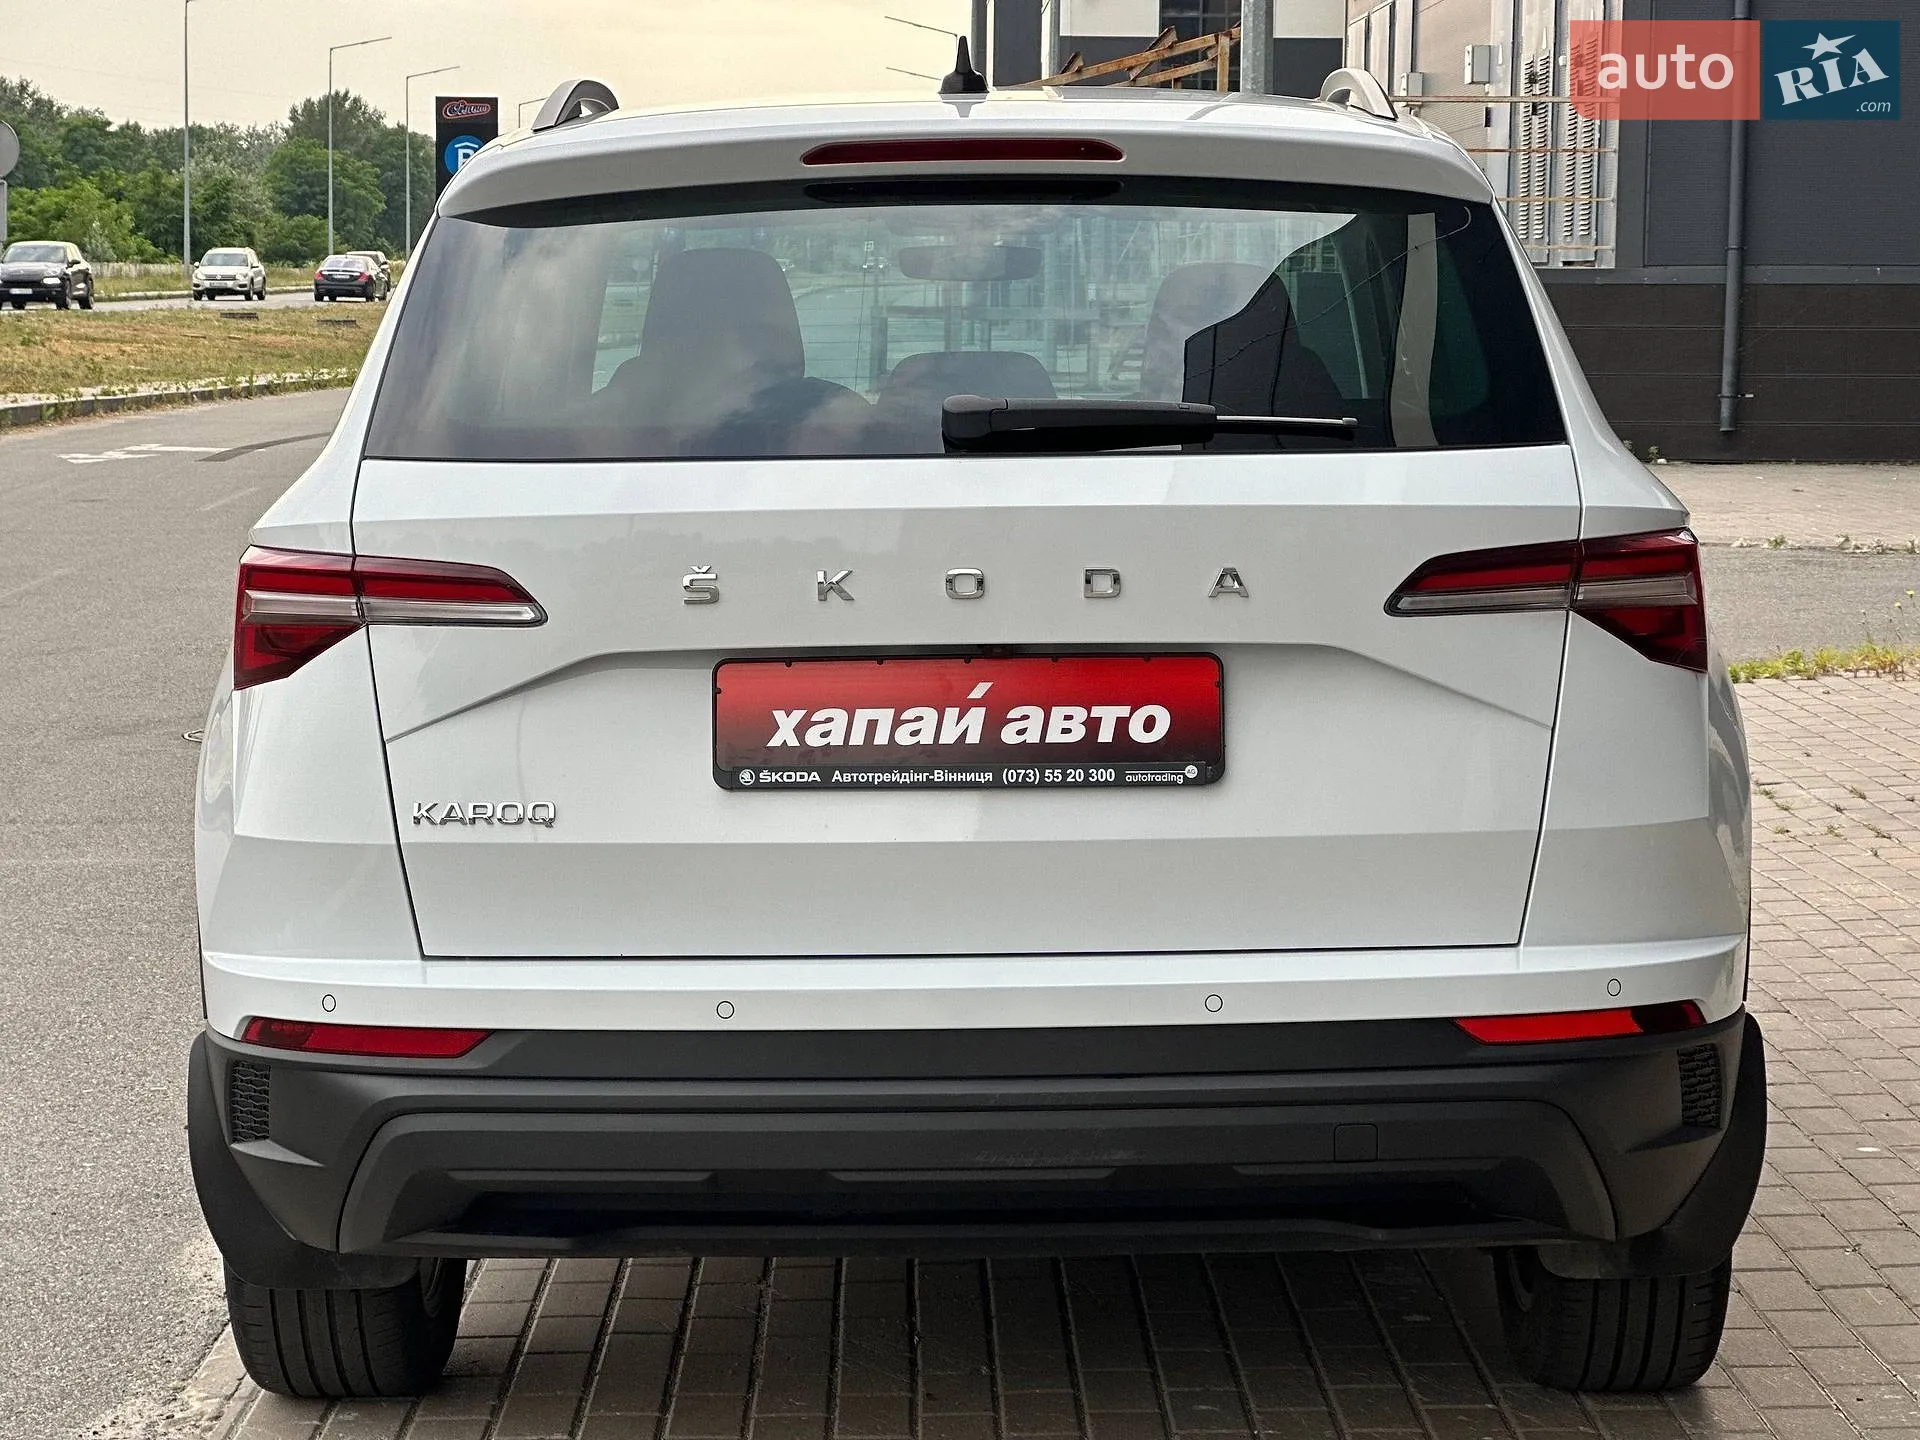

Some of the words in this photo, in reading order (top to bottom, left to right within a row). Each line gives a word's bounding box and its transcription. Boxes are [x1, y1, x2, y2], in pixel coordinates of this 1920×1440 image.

[683, 564, 1249, 605] ŠKODA
[1000, 704, 1171, 745] авто
[759, 768, 821, 783] ŠKODA
[831, 769, 993, 785] Автотрейдінг-Вінниця
[1002, 768, 1040, 785] (073)
[1044, 768, 1063, 783] 55
[1066, 768, 1085, 782] 20
[1089, 768, 1116, 782] 300
[1125, 773, 1184, 785] autotrading
[412, 801, 557, 828] KAROQ
